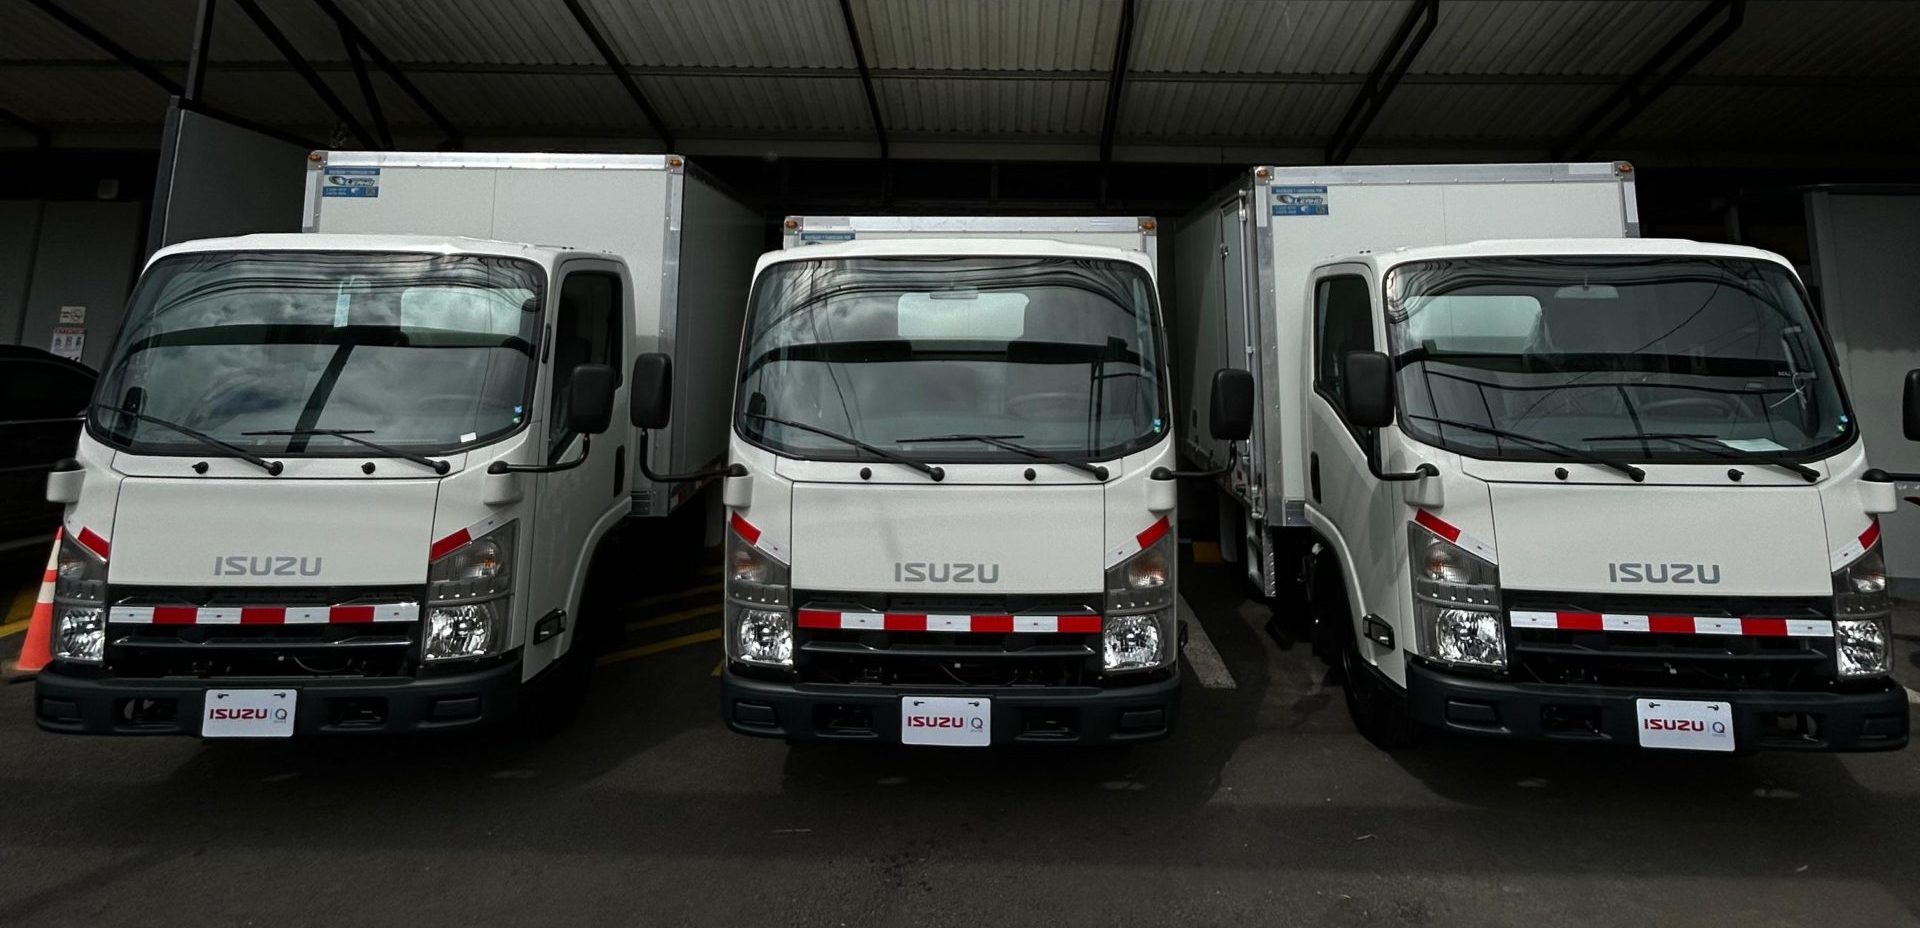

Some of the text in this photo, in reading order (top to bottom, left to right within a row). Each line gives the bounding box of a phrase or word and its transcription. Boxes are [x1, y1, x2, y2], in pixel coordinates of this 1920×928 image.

[214, 556, 322, 576] ISUZU
[895, 562, 999, 583] ISUZU
[1609, 563, 1720, 584] ISUZU
[209, 708, 268, 720] ISUZU
[907, 716, 964, 728] ISUZU
[1644, 719, 1704, 731] ISUZU
